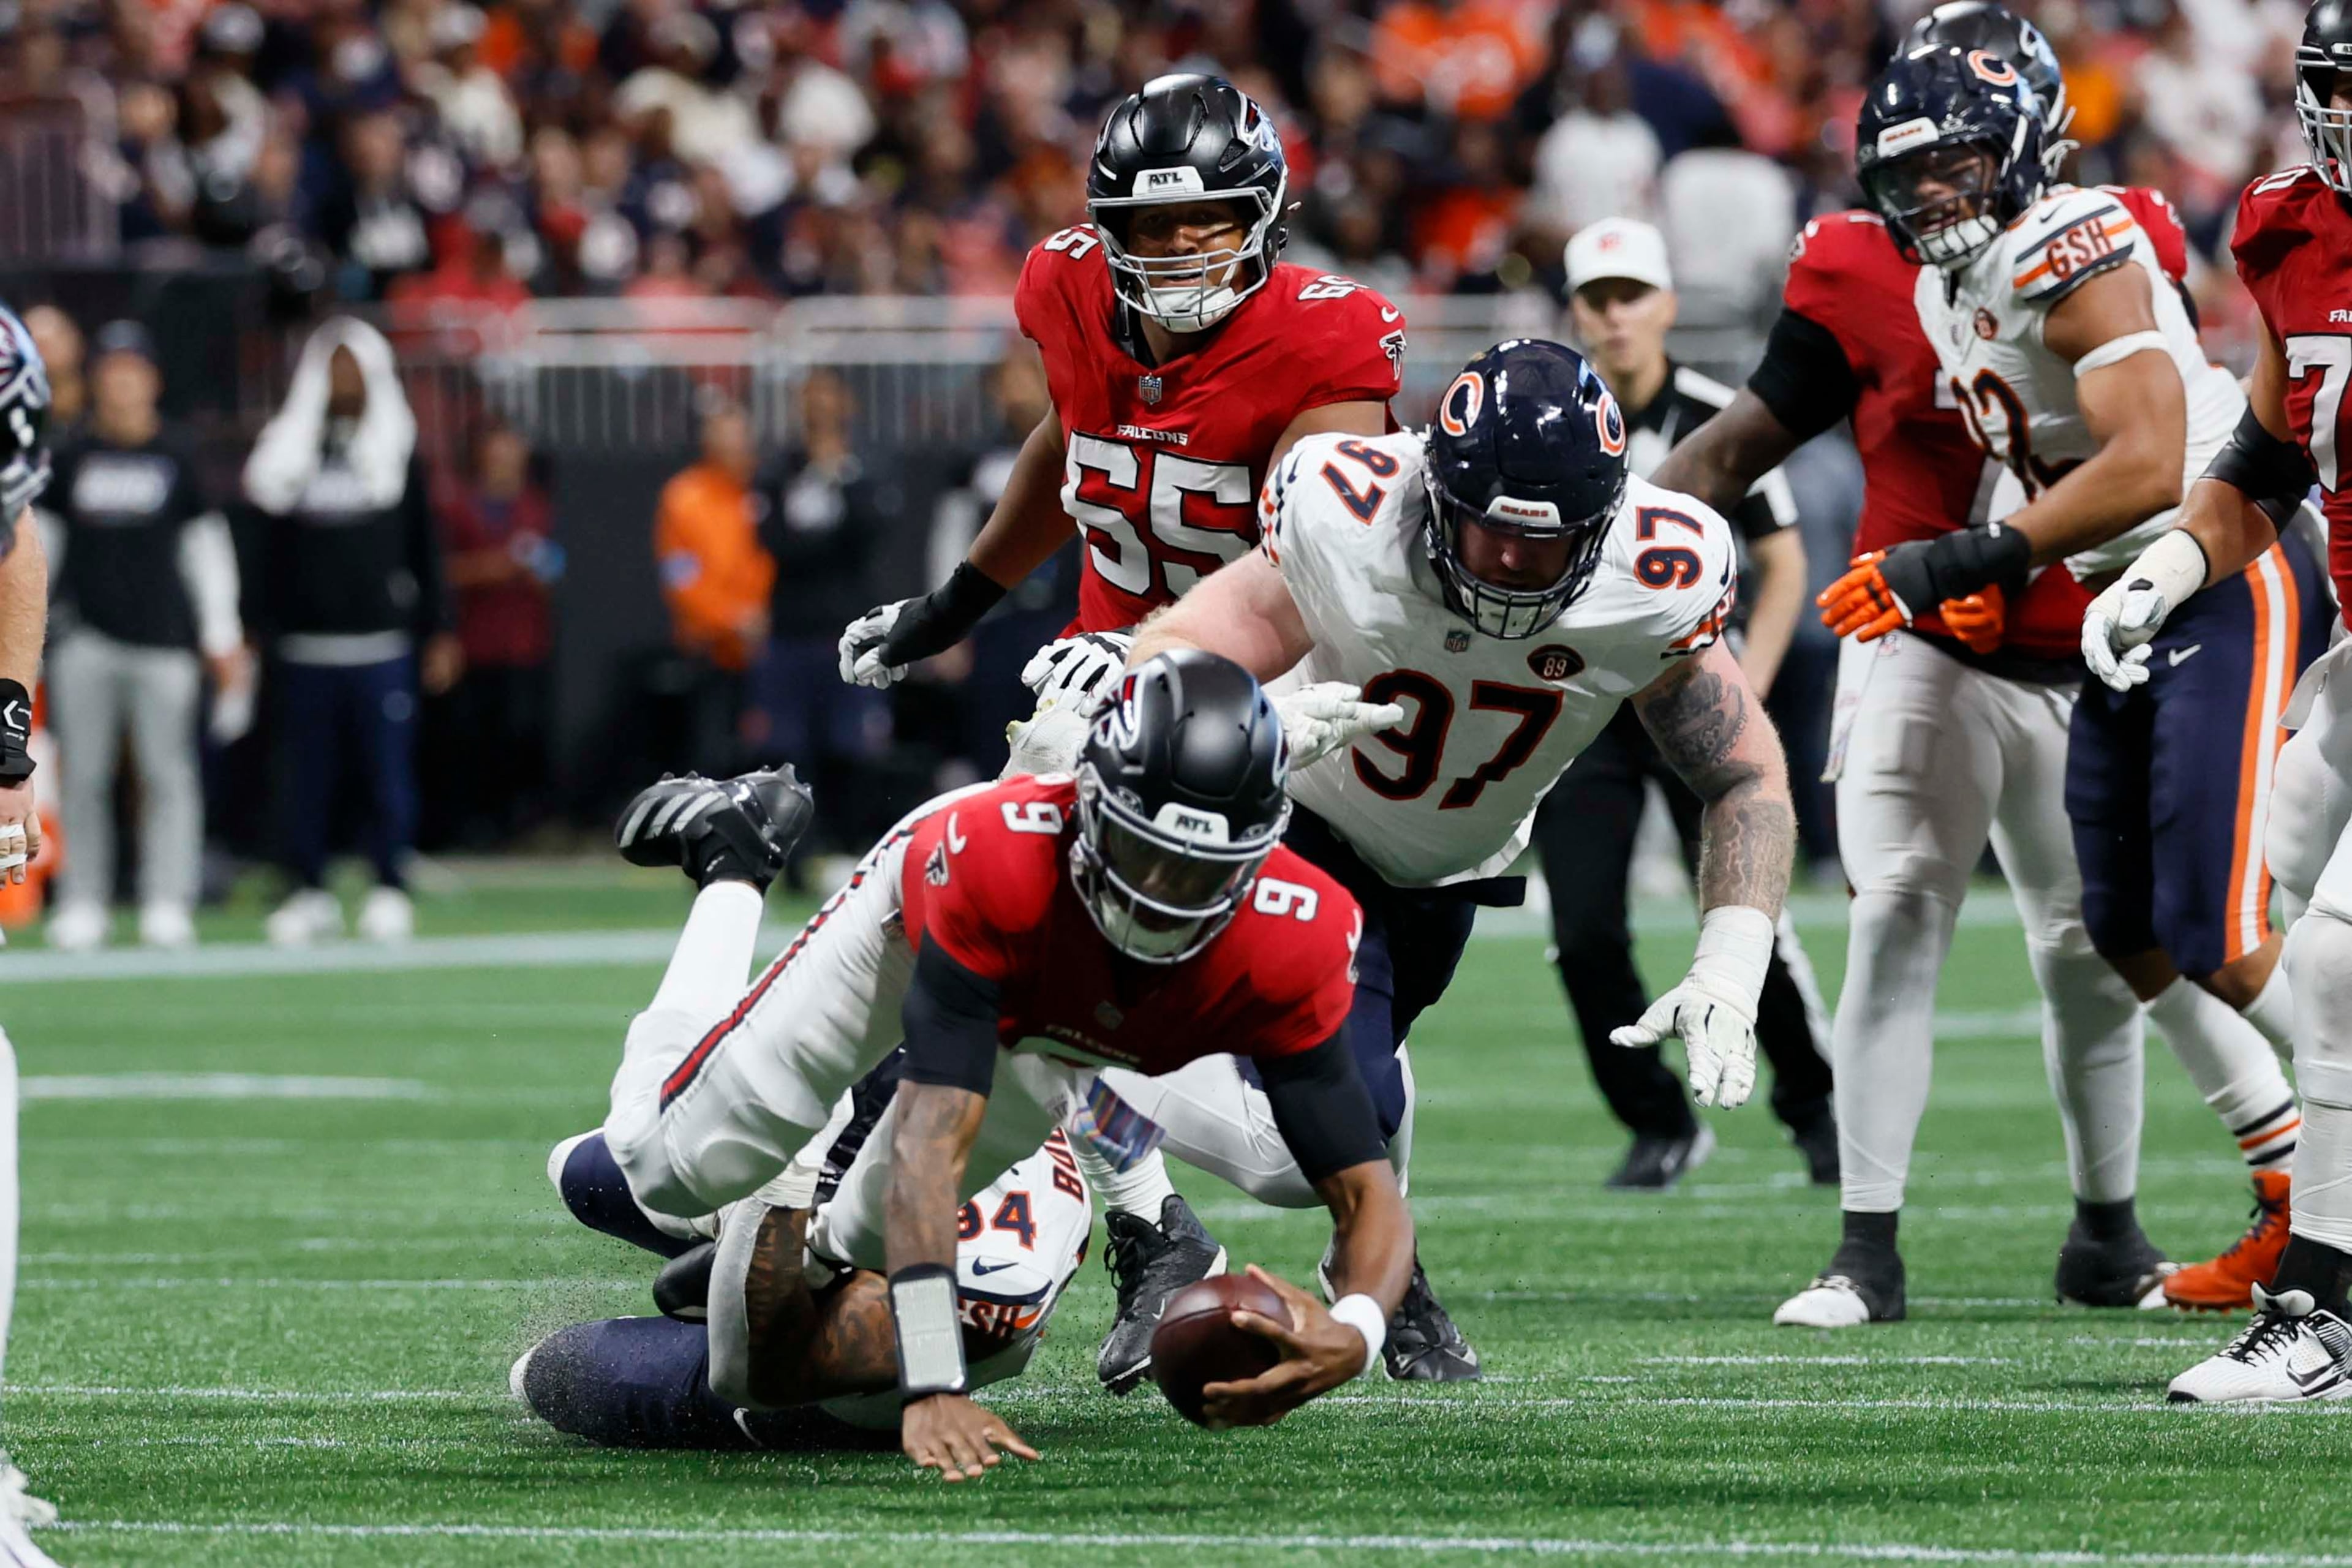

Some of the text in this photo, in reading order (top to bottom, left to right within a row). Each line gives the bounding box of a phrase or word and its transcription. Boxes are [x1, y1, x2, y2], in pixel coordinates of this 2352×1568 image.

[1148, 172, 1183, 187] ATL
[2045, 216, 2115, 282] GSH
[1117, 424, 1188, 447] FALCONS
[1319, 440, 1400, 526] 97
[1060, 429, 1253, 597] 65
[1501, 505, 1548, 518] BEARS
[1634, 506, 1704, 590] 97
[1544, 657, 1567, 677] 89
[1351, 668, 1564, 810] 97
[1000, 801, 1064, 835] 9
[1175, 813, 1213, 834] ATL
[1253, 876, 1319, 921] 9
